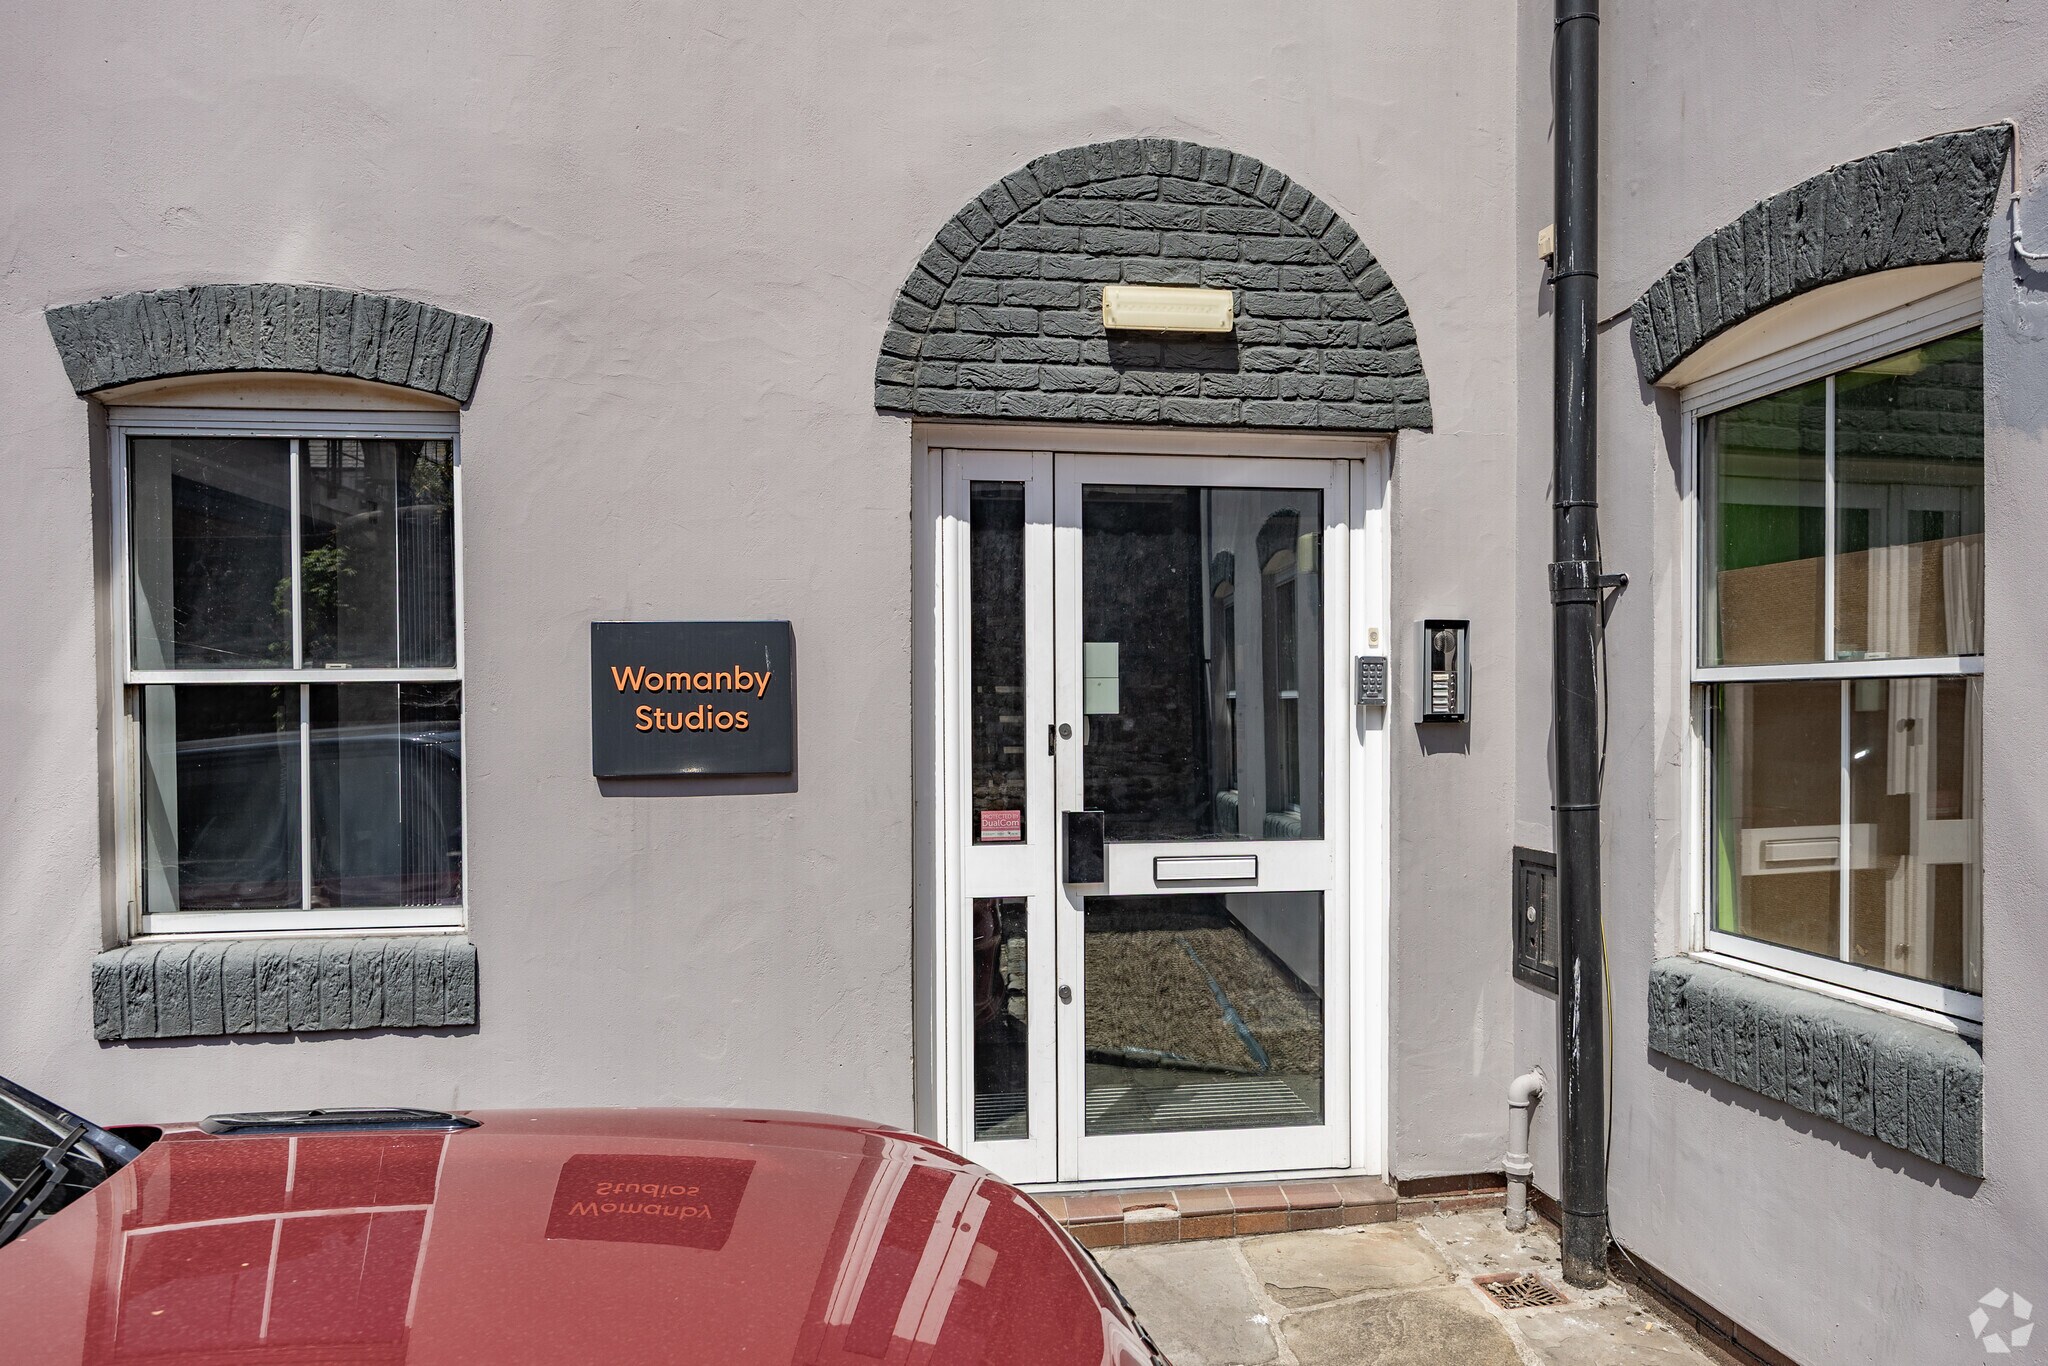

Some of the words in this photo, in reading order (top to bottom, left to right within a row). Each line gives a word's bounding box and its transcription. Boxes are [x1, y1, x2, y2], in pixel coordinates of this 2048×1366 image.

[611, 665, 772, 698] Womanby
[635, 704, 749, 731] Studios
[982, 819, 1020, 827] DualCom
